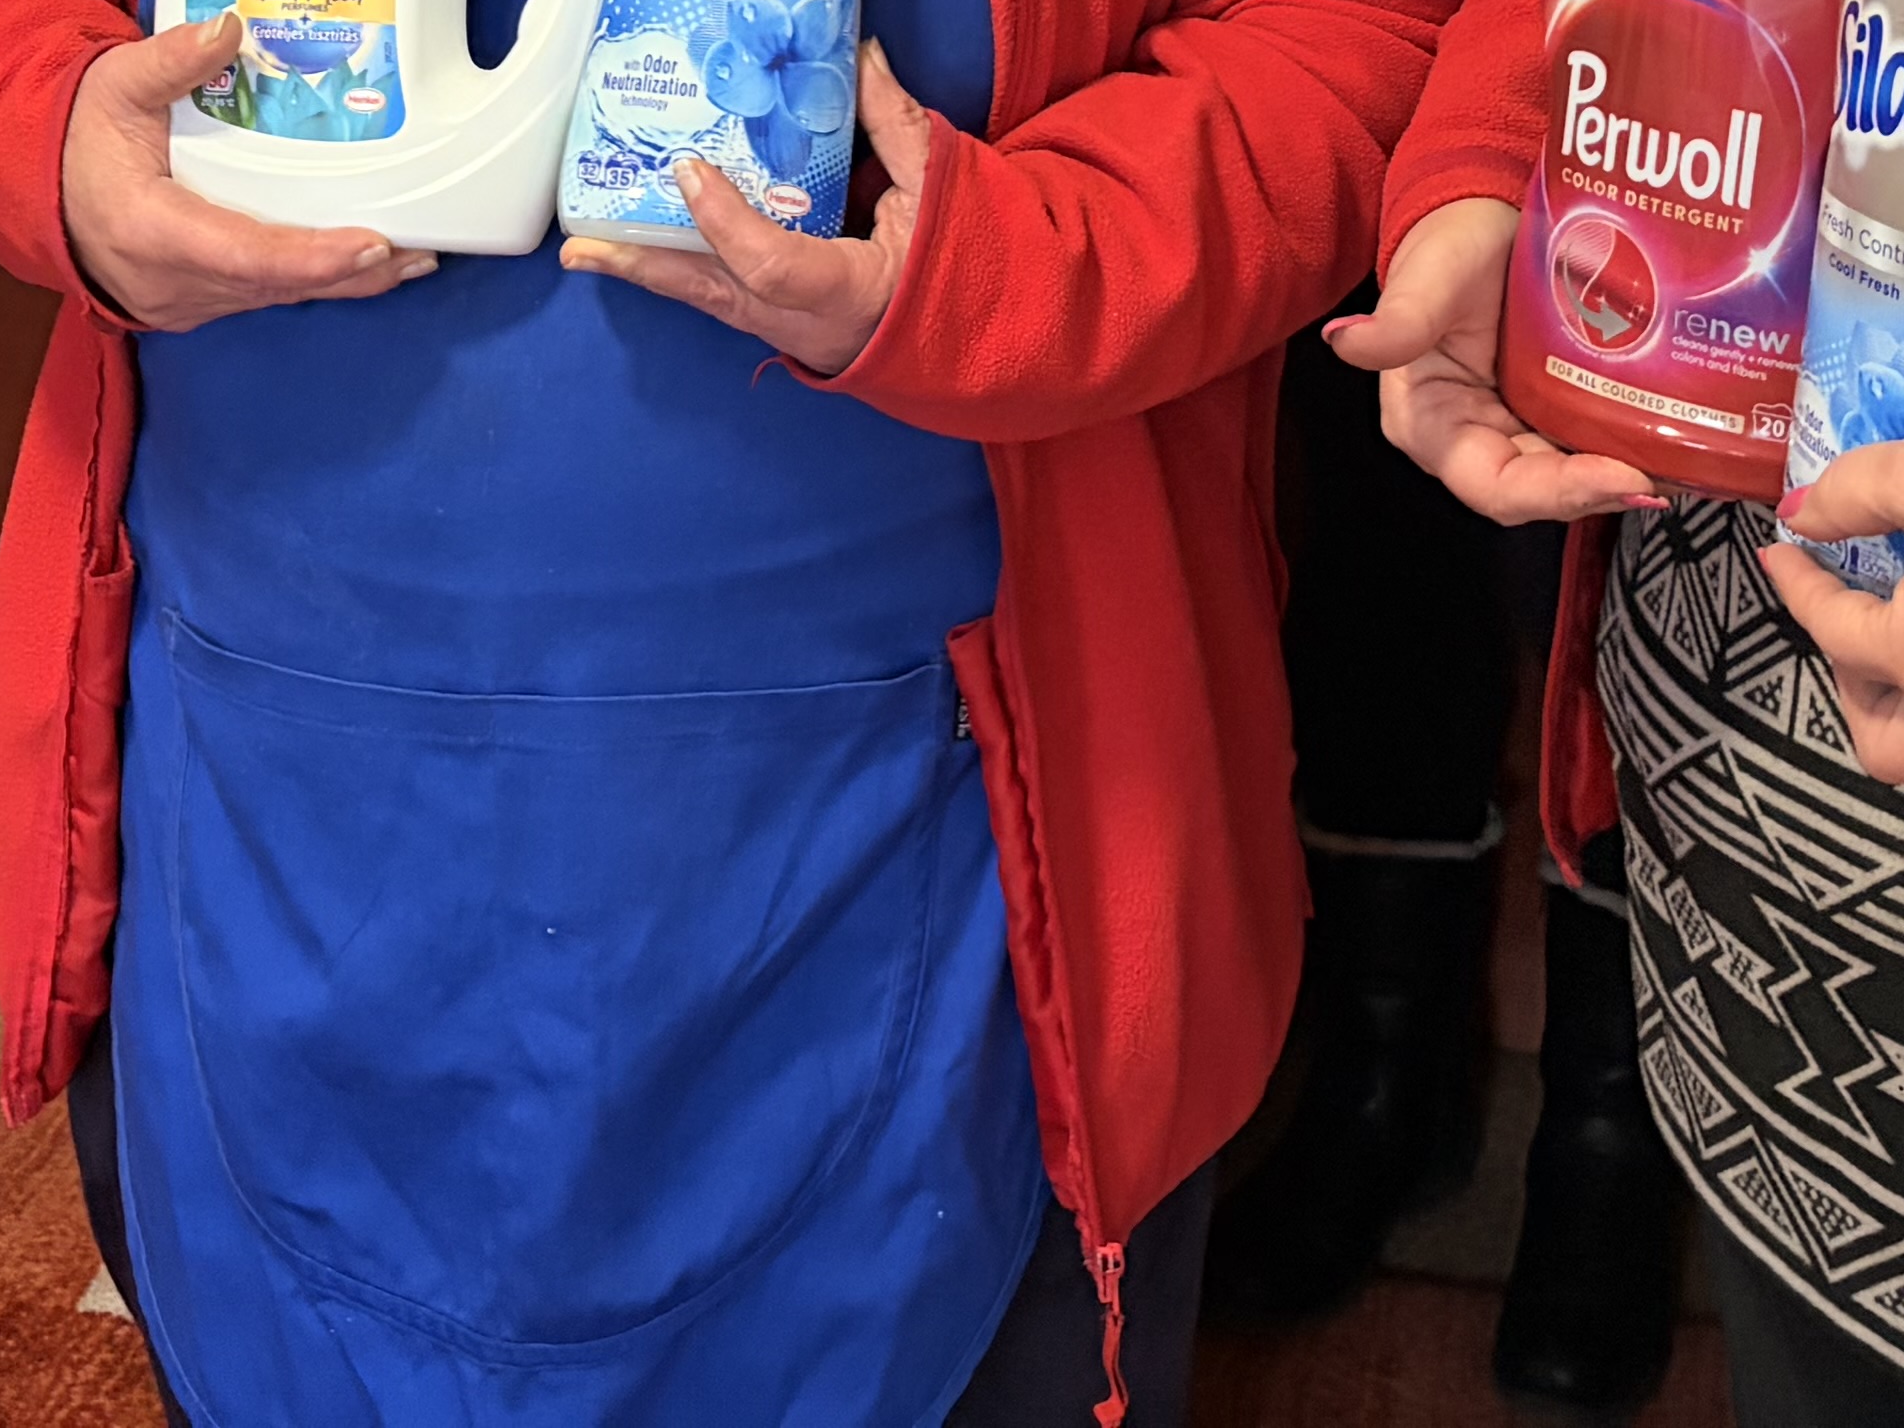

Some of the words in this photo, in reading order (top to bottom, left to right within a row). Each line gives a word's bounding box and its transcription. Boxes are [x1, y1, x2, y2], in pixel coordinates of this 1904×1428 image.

[643, 54, 678, 75] Odor
[602, 71, 698, 98] Neutralization
[1561, 50, 1763, 210] Perwoll
[609, 170, 631, 186] 35
[1561, 167, 1619, 202] COLOR
[1624, 190, 1745, 235] DETERGENT
[1822, 203, 1854, 242] Fresh
[1828, 252, 1855, 280] Cool
[1859, 270, 1900, 301] Fresh
[1673, 308, 1790, 355] renew
[1670, 351, 1705, 368] colors
[1706, 358, 1730, 375] and
[1732, 363, 1768, 381] fibers
[1710, 344, 1746, 363] gently
[1551, 360, 1574, 378] FOR
[1576, 372, 1597, 389] ALL
[1601, 381, 1666, 411] COLORED
[1670, 402, 1738, 429] CLOTHES
[1760, 416, 1786, 438] 20
